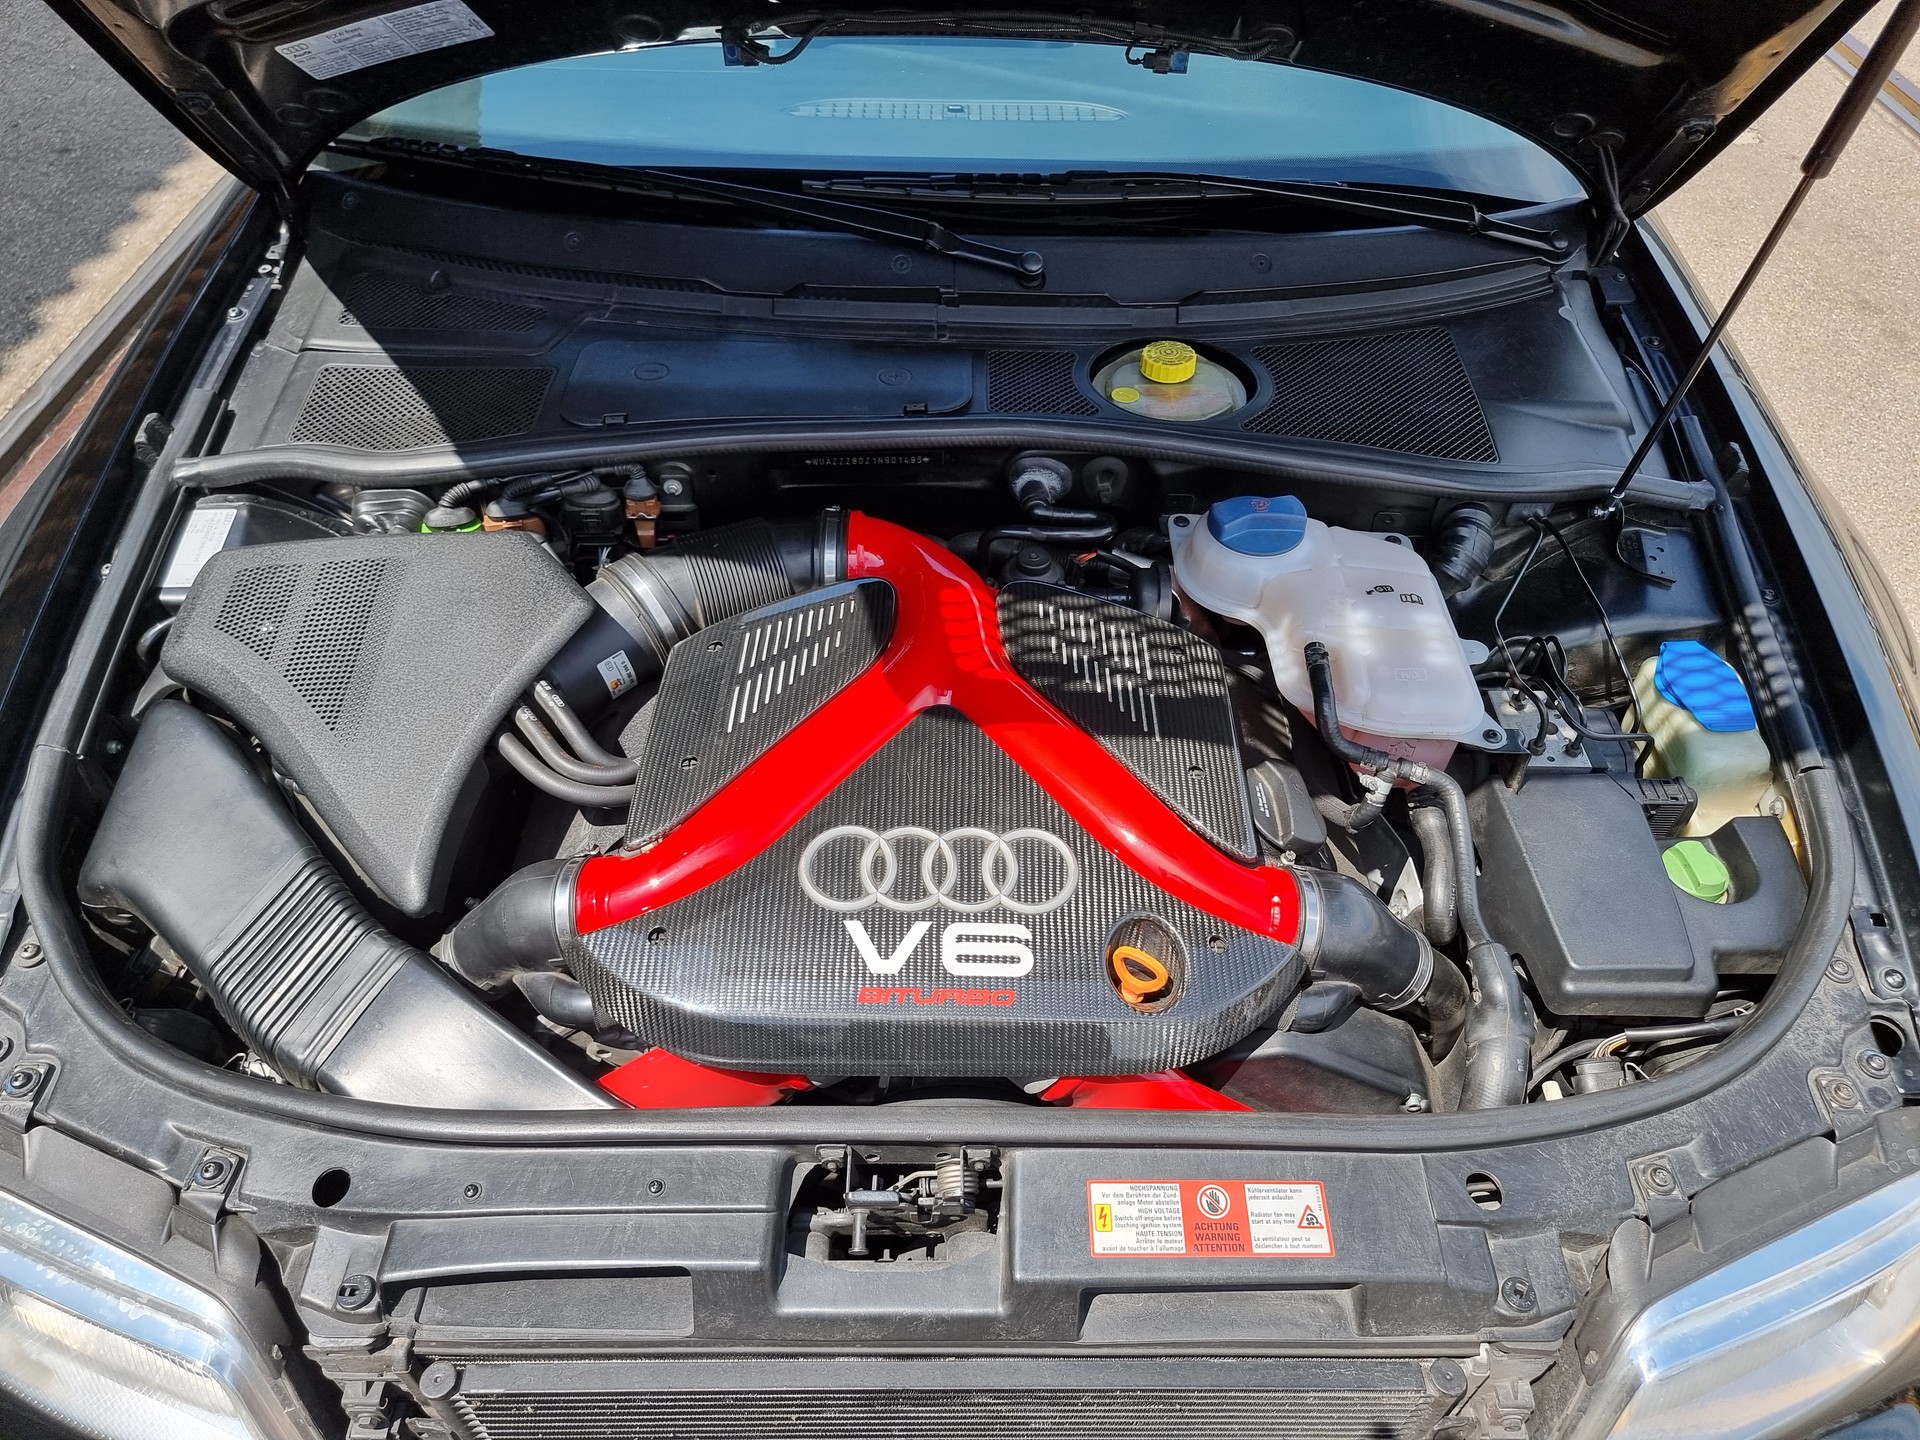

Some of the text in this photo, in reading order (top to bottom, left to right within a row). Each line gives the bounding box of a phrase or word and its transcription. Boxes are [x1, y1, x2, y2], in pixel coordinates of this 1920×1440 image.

[843, 920, 1034, 978] V6
[857, 986, 1017, 1006] BITURBO
[1195, 1222, 1239, 1230] ACHTUNG
[1195, 1233, 1240, 1241] WARNING
[1193, 1243, 1245, 1252] ATTENTION
